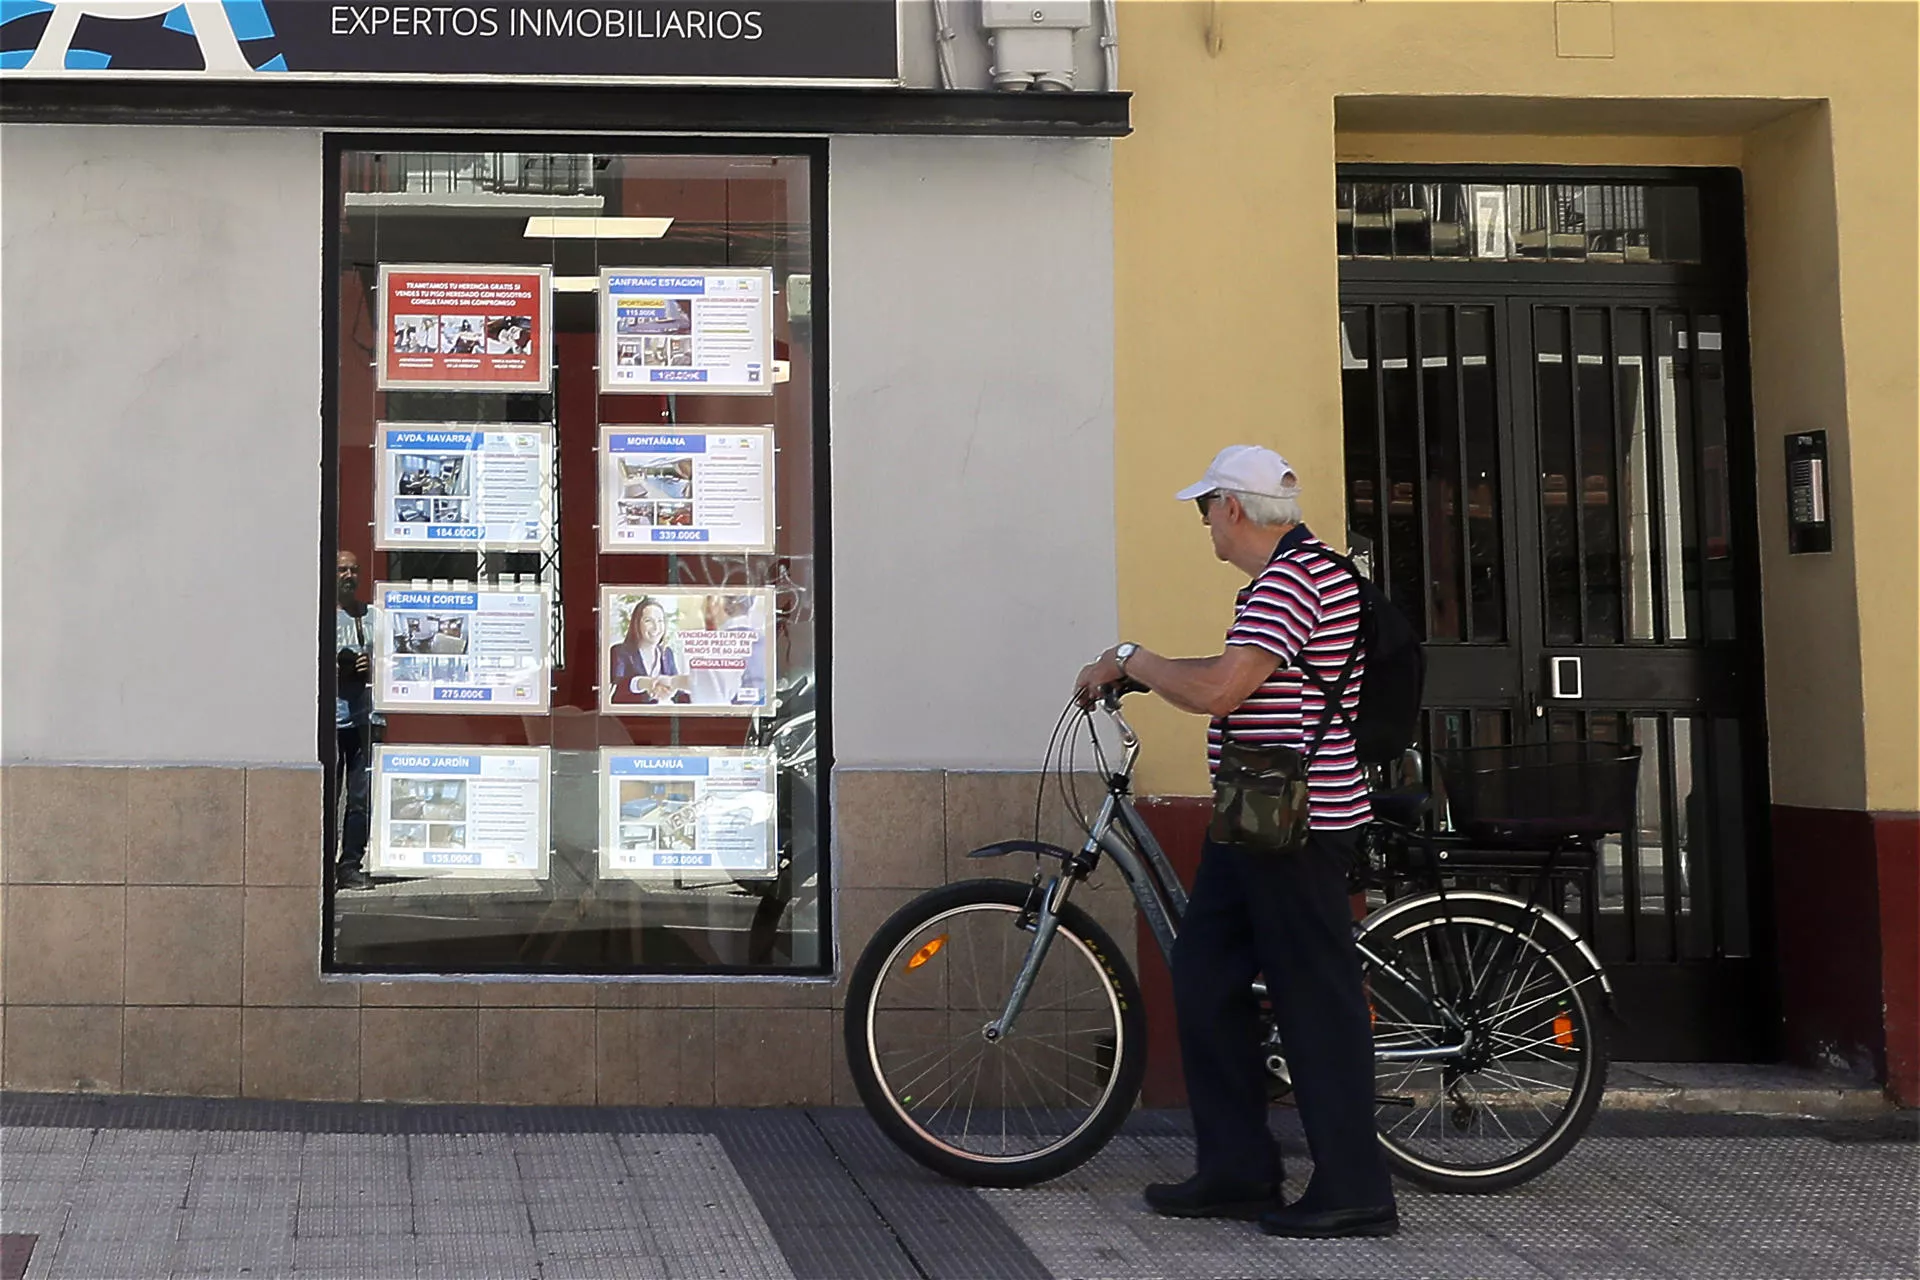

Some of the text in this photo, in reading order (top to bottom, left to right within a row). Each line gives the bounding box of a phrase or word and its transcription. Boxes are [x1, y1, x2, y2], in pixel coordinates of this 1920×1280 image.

[331, 7, 764, 41] EXPERTOS INMOBILIARIOS
[1480, 196, 1500, 252] 7
[608, 278, 657, 287] CANFRANC
[396, 434, 472, 443] AVDA. NAVARRA
[627, 436, 686, 446] MONTAÑANA
[435, 527, 478, 537] 184.000€
[659, 531, 701, 540] 339.000€
[441, 689, 484, 699] 275.000€
[391, 756, 430, 767] CIUDAD
